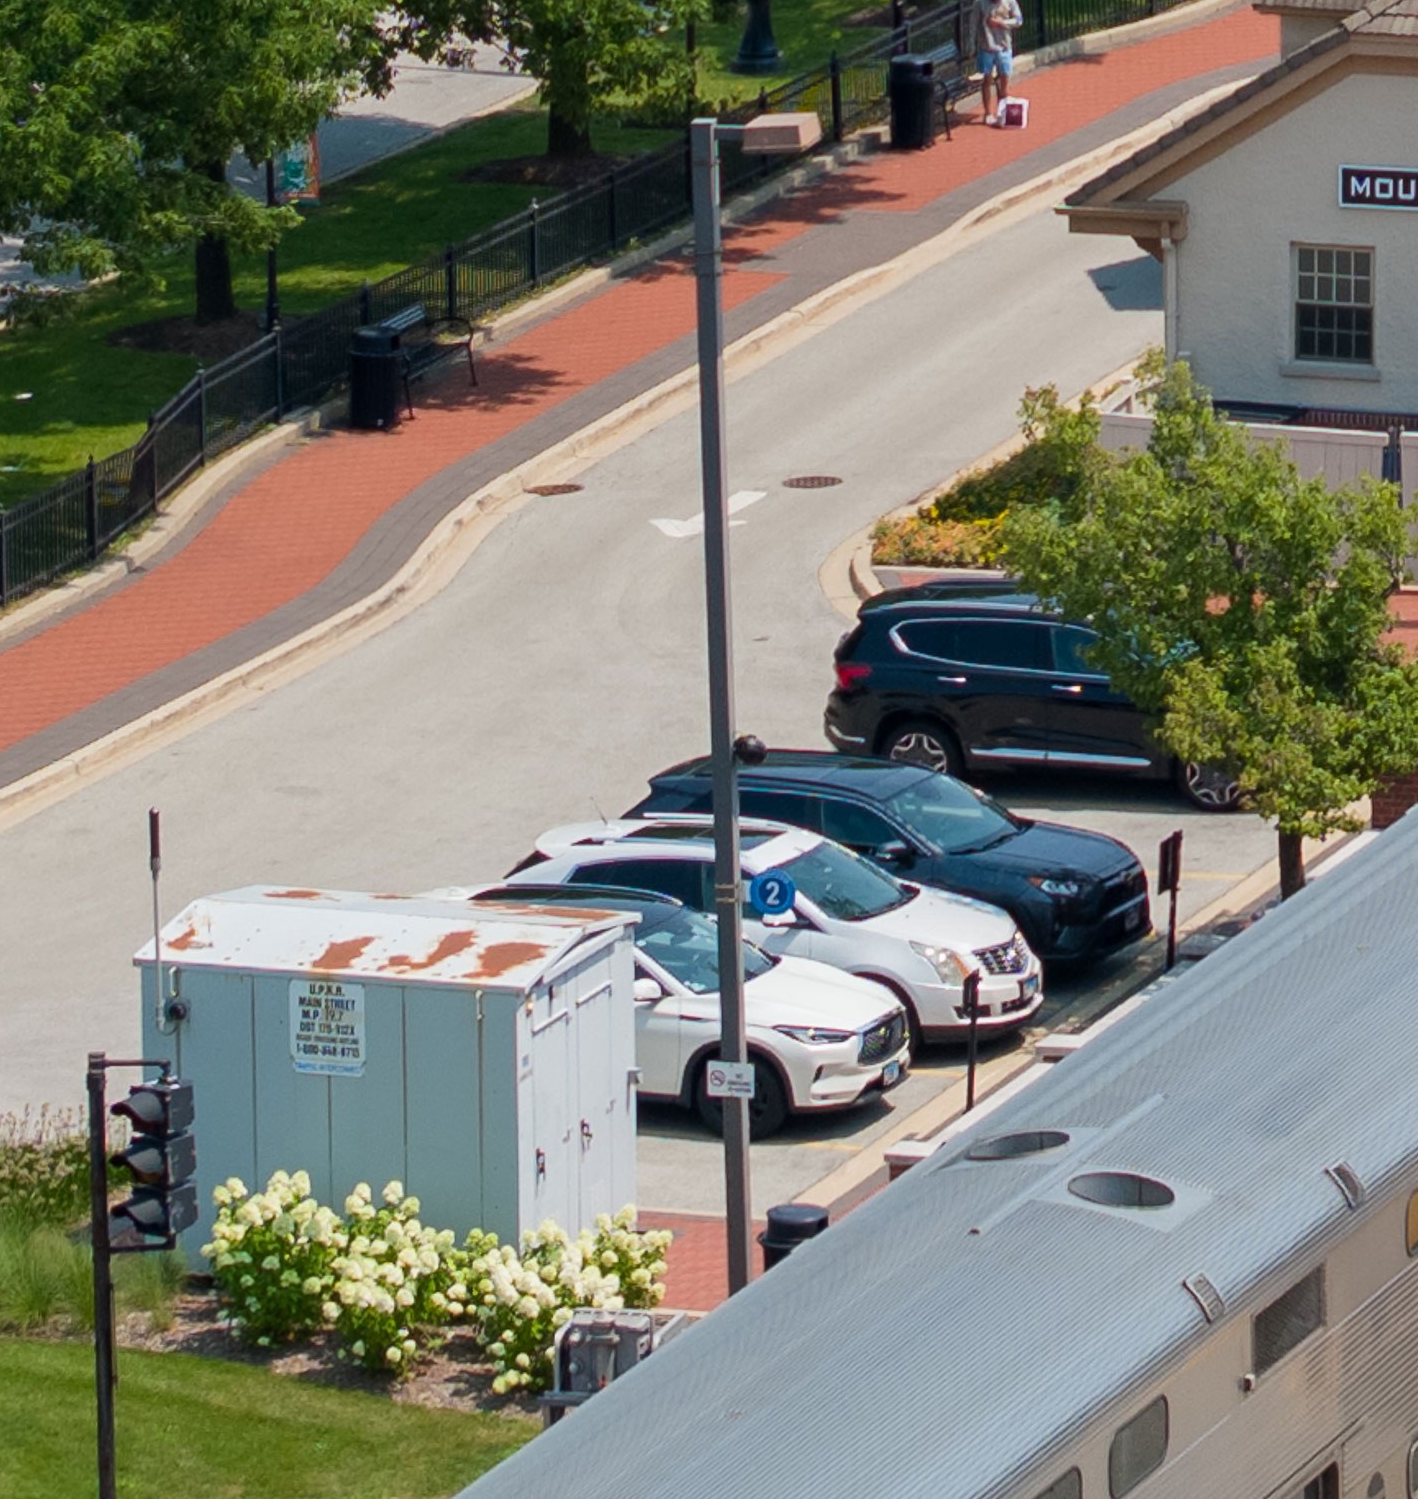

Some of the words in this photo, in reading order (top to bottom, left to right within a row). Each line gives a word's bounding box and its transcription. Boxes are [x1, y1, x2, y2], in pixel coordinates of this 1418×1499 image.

[766, 882, 780, 906] 2
[299, 997, 322, 1008] MAIN
[325, 998, 355, 1011] STREET
